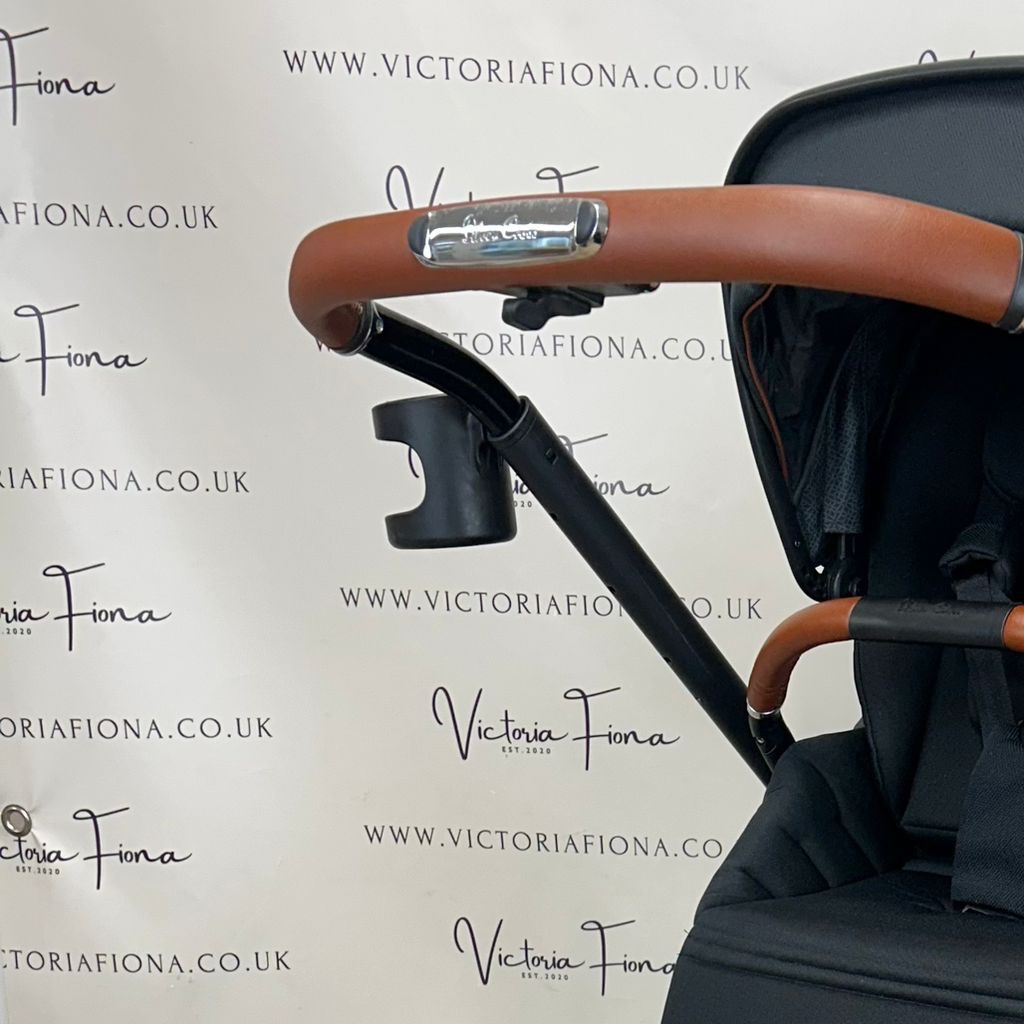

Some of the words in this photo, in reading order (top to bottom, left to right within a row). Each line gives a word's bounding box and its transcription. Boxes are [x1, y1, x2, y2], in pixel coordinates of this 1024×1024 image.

[0, 27, 116, 126] Fiona
[283, 49, 751, 91] WWW.VICTORIAFIONA.CO.UK
[14, 304, 148, 396] Fiona
[43, 562, 172, 652] Fiona
[432, 686, 569, 761] Victoria
[563, 686, 681, 771] Fiona
[501, 746, 552, 755] EST.2020
[73, 807, 192, 890] Fiona
[2, 949, 291, 974] TORIAFIONA.CO.UK
[454, 917, 586, 985] Victoria
[521, 972, 569, 981] EST.2020
